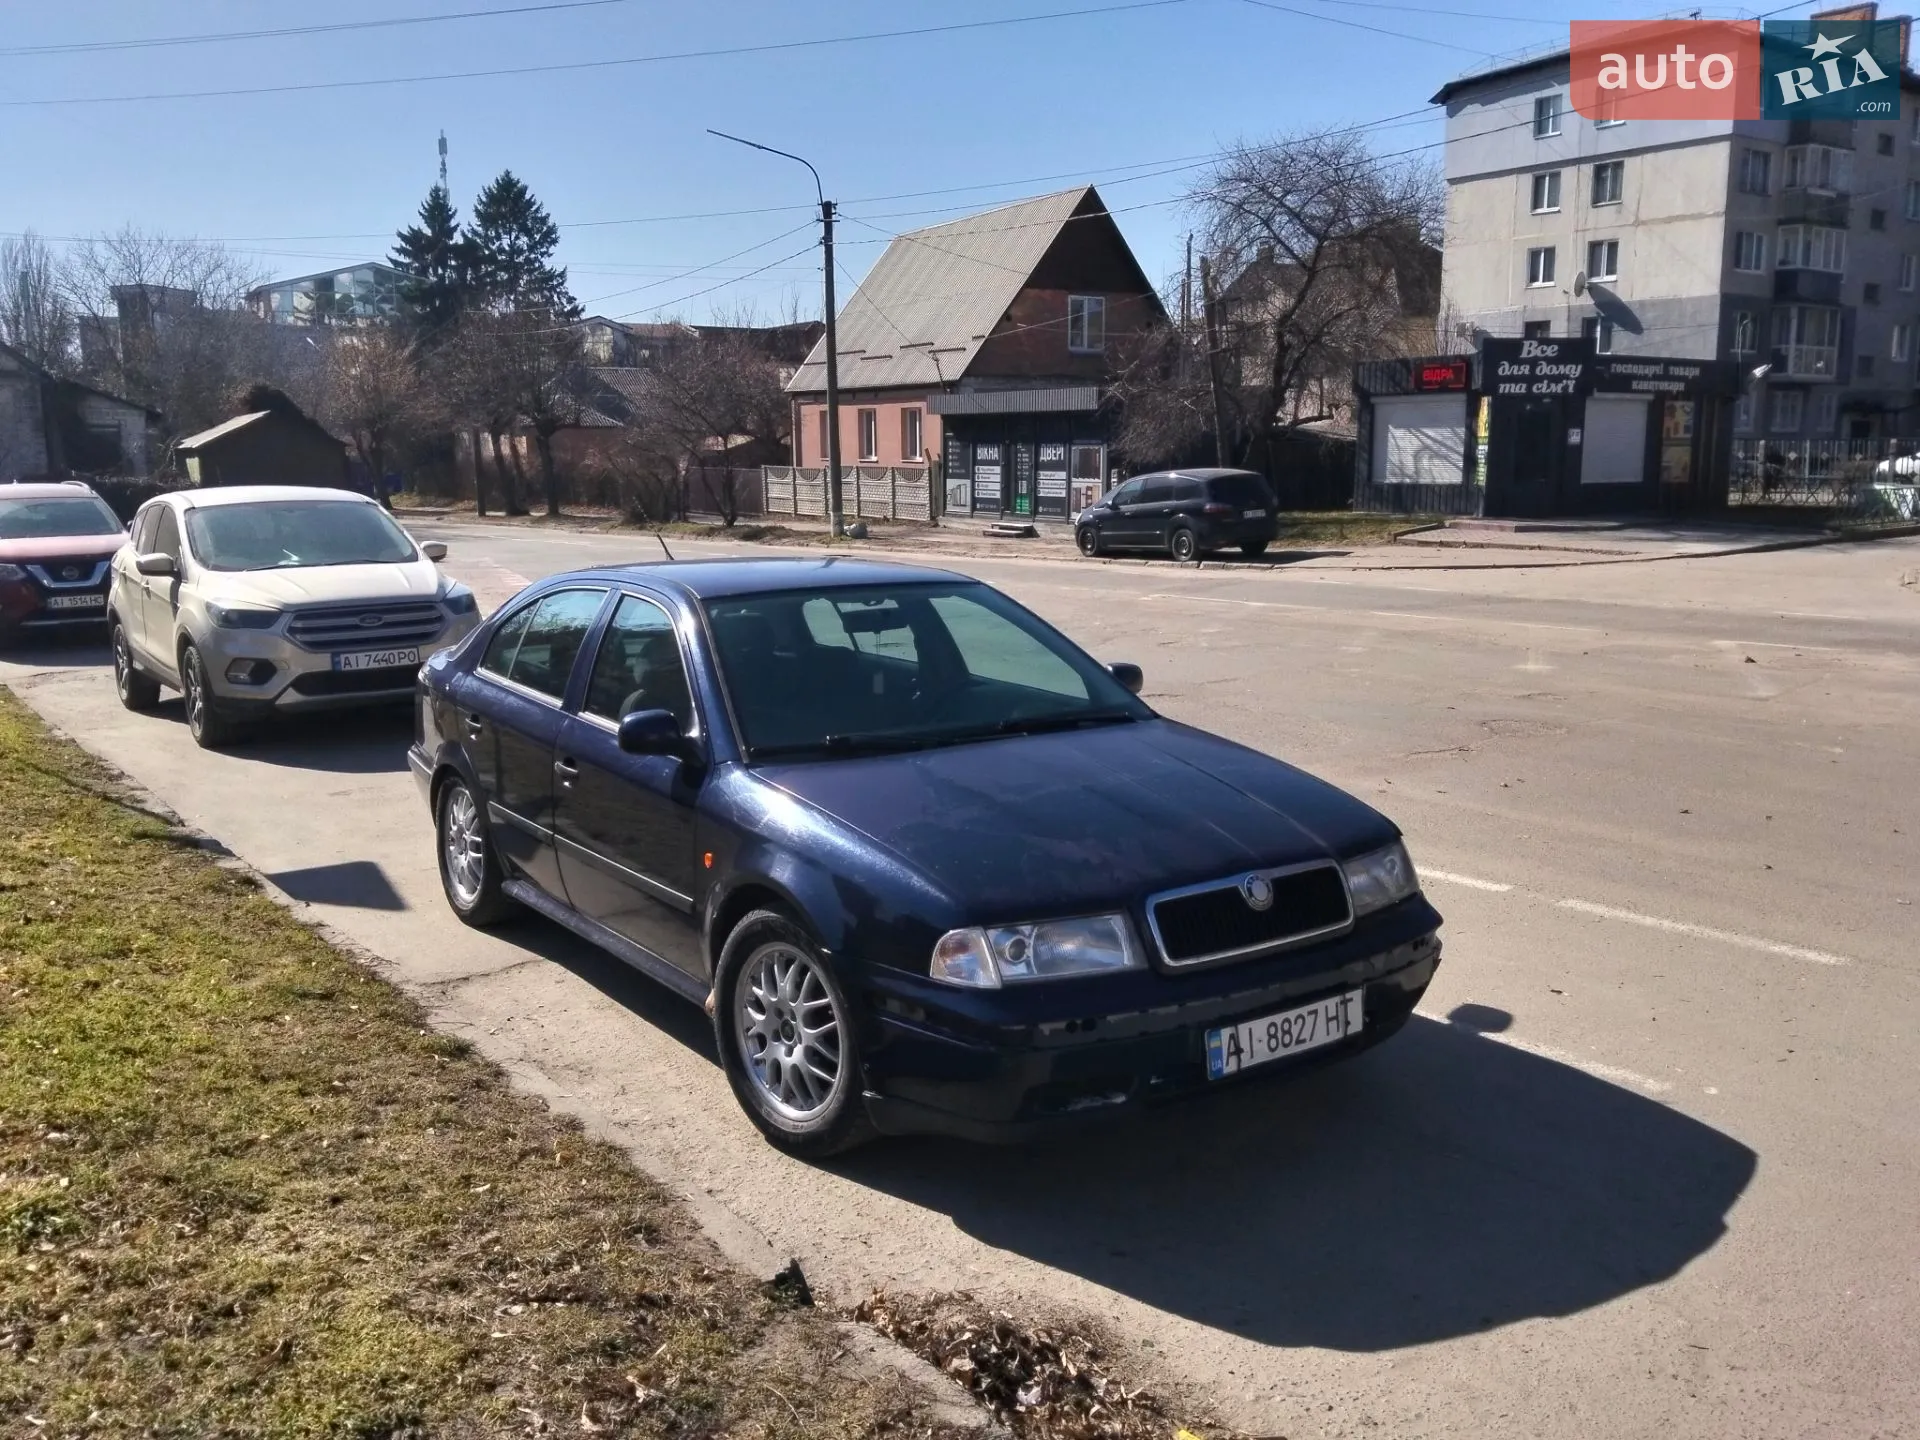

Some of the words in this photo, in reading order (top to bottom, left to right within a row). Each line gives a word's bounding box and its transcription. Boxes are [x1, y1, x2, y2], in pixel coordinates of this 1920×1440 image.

[1520, 340, 1559, 358] Все
[1497, 360, 1531, 376] для
[1535, 360, 1582, 378] дому
[1498, 382, 1527, 394] та
[977, 443, 999, 461] ВІКНА
[1039, 443, 1064, 462] ДВЕРІ
[343, 655, 360, 669] AI
[364, 652, 396, 668] 7440
[1266, 1008, 1319, 1053] 8827
